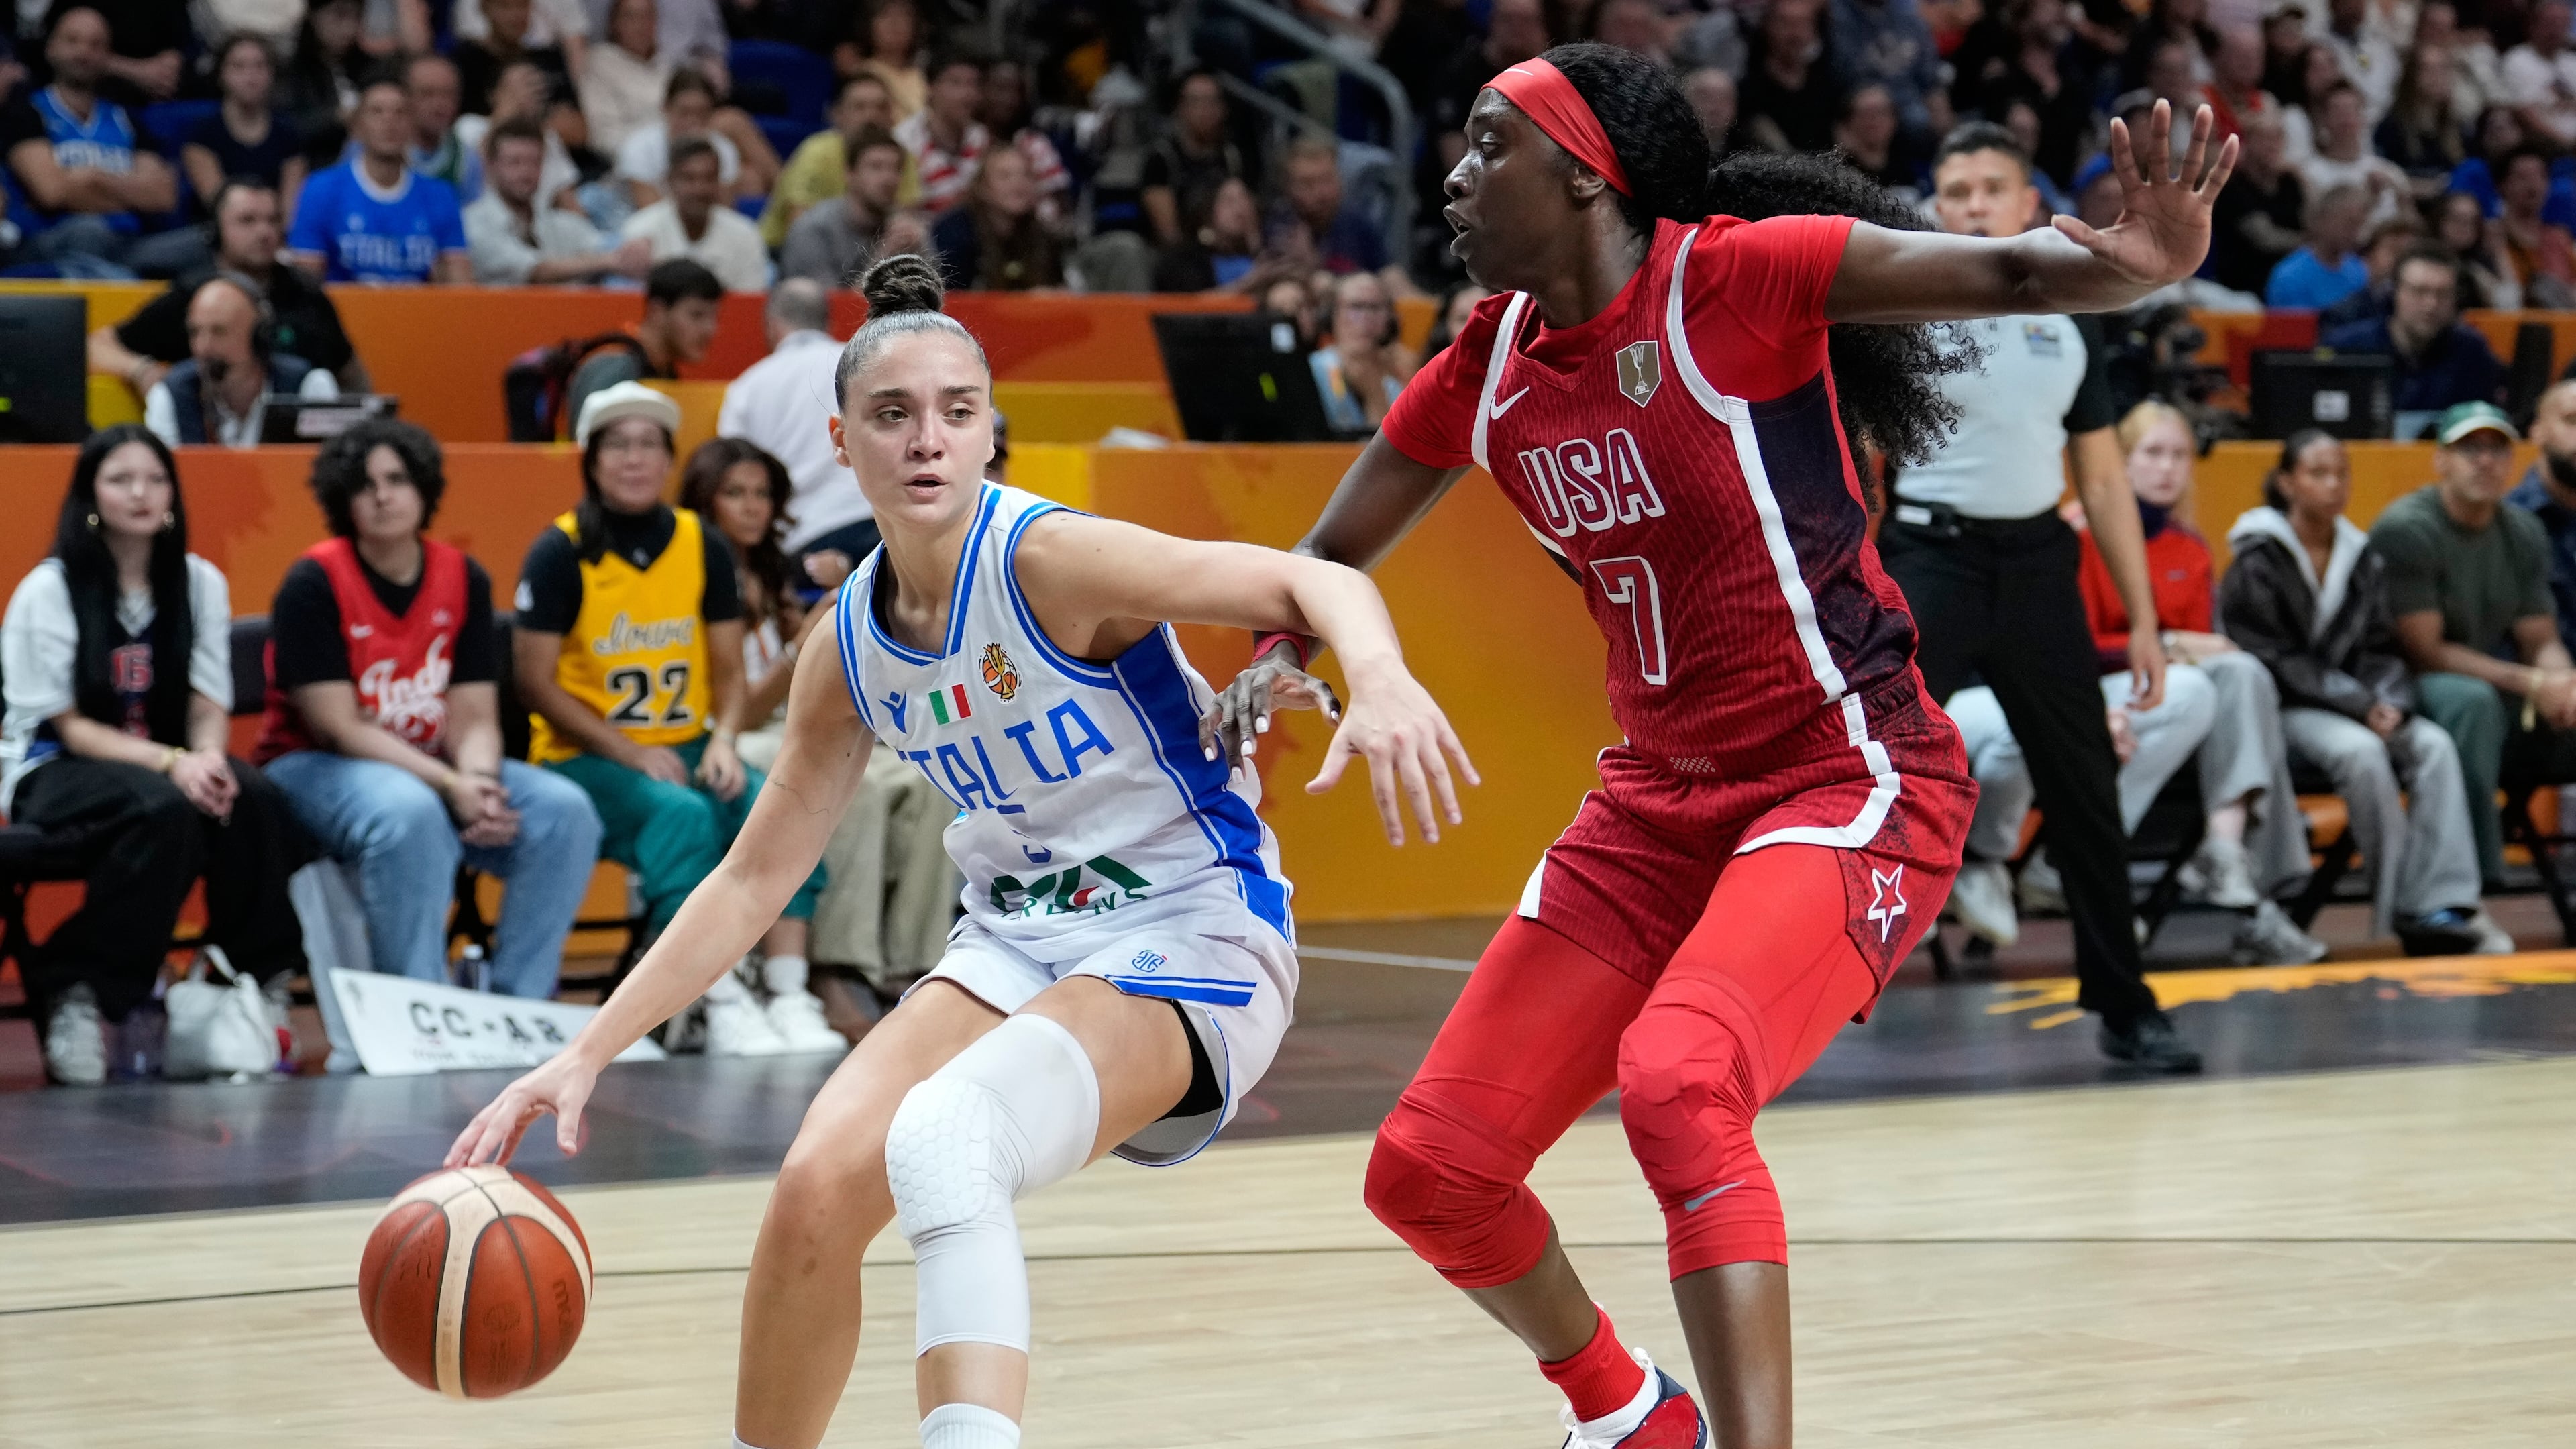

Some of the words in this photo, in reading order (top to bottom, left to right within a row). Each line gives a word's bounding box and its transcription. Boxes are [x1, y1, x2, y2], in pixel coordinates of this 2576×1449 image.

[1517, 427, 1666, 538] USA
[1588, 555, 1668, 686] 7
[605, 659, 696, 732] 22
